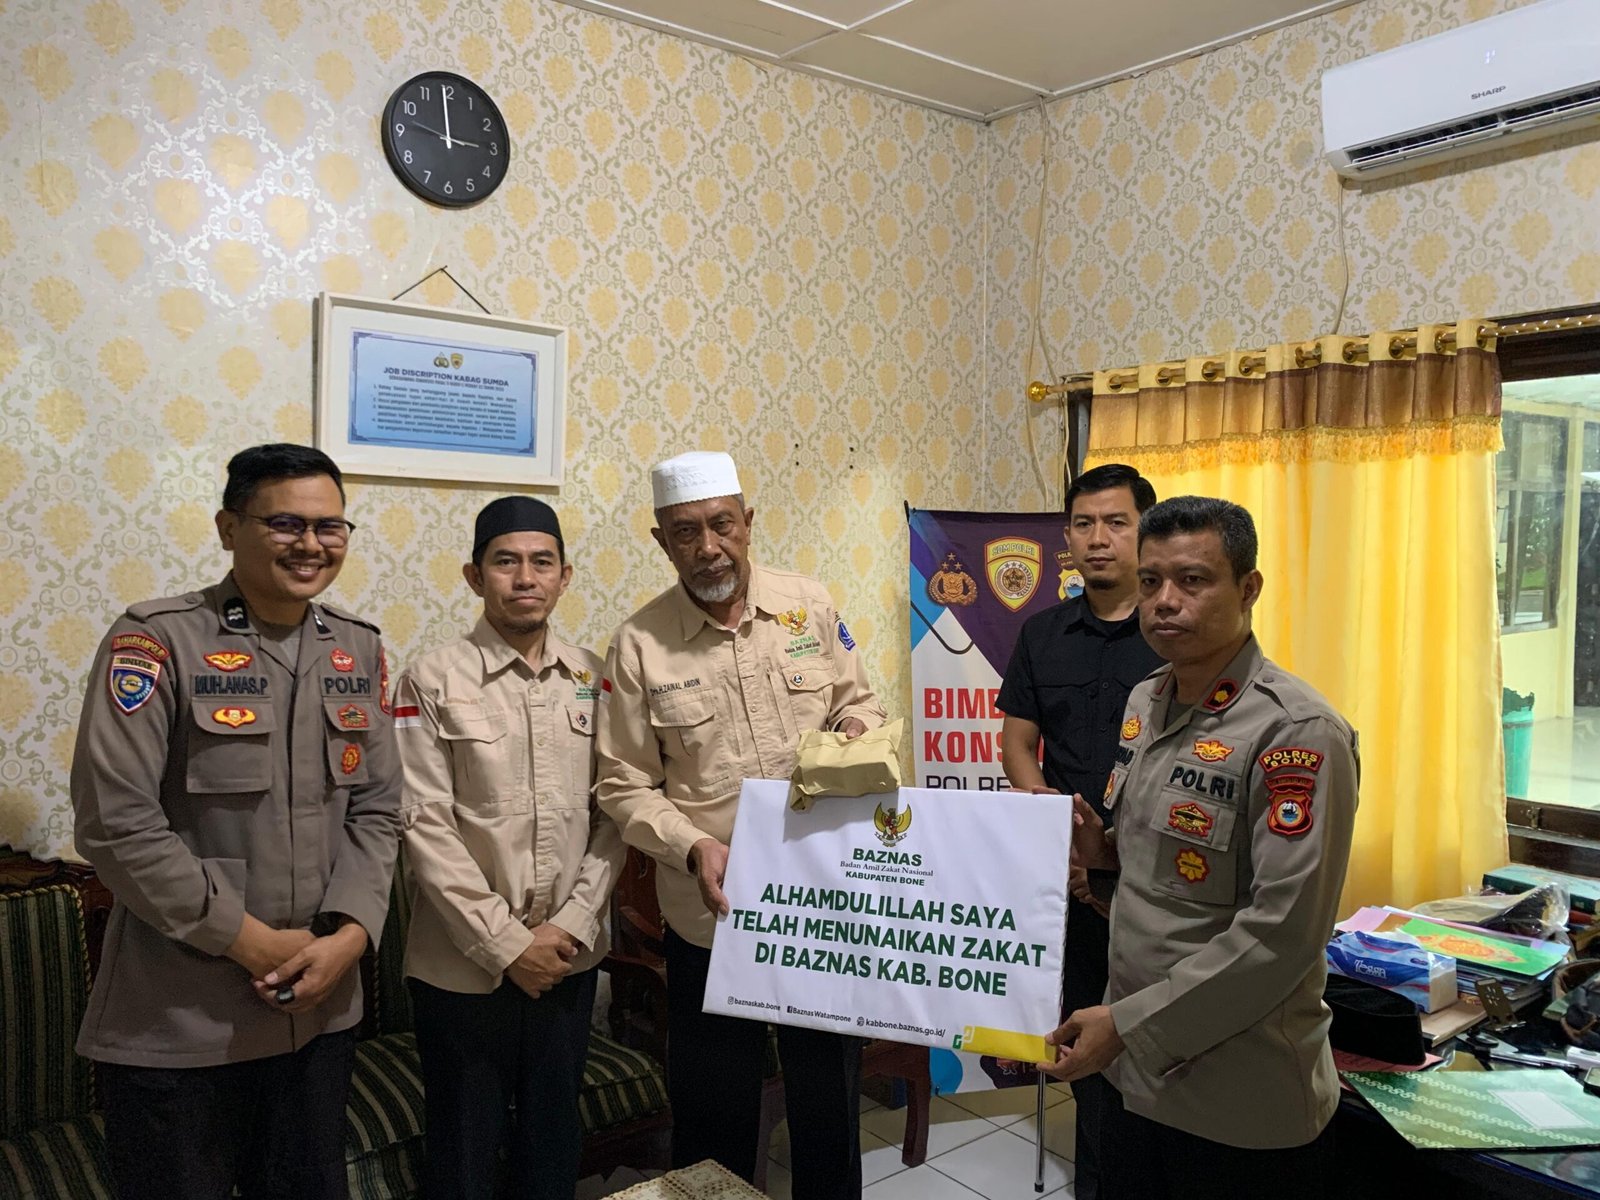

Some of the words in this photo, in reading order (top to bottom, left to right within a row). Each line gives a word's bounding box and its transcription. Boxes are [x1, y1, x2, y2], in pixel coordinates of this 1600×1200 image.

[420, 85, 430, 101] 11
[440, 84, 455, 101] 2
[1470, 85, 1507, 100] SHARP
[402, 100, 417, 116] 10
[468, 96, 473, 111] 1
[395, 123, 405, 137] 9
[482, 118, 492, 132] 2
[403, 149, 414, 164] 8
[489, 142, 498, 156] 3
[423, 170, 432, 184] 7
[482, 165, 491, 178] 4
[443, 181, 454, 194] 6
[465, 179, 475, 192] 5
[383, 367, 400, 375] JOB
[401, 368, 455, 381] DISCRIPTION
[454, 374, 482, 384] KABAG
[482, 377, 510, 387] SUMDA
[323, 676, 371, 694] POLRI
[1263, 750, 1318, 765] POLRES
[1270, 757, 1312, 768] BONE
[1169, 766, 1235, 799] POLRI
[852, 847, 922, 867] BAZNAS
[840, 860, 861, 869] Badan
[863, 863, 880, 871] Amil
[880, 865, 900, 873] Zakat
[902, 866, 934, 877] Nasional
[845, 870, 897, 883] KABUPATEN
[899, 876, 925, 886] BONE
[760, 883, 944, 924] ALHAMDULILLAH
[950, 902, 1016, 931] SAYA
[732, 909, 799, 937] TELAH
[803, 918, 955, 954] MENUNAIKAN
[961, 936, 1047, 967] ZAKAT
[755, 942, 775, 965] DI
[781, 946, 871, 978] BAZNAS
[877, 957, 932, 986] KAB.
[938, 968, 1008, 996] BONE
[734, 997, 781, 1011] baznaskab.bone
[865, 1018, 946, 1038] kabbone.baznas.go.id/
